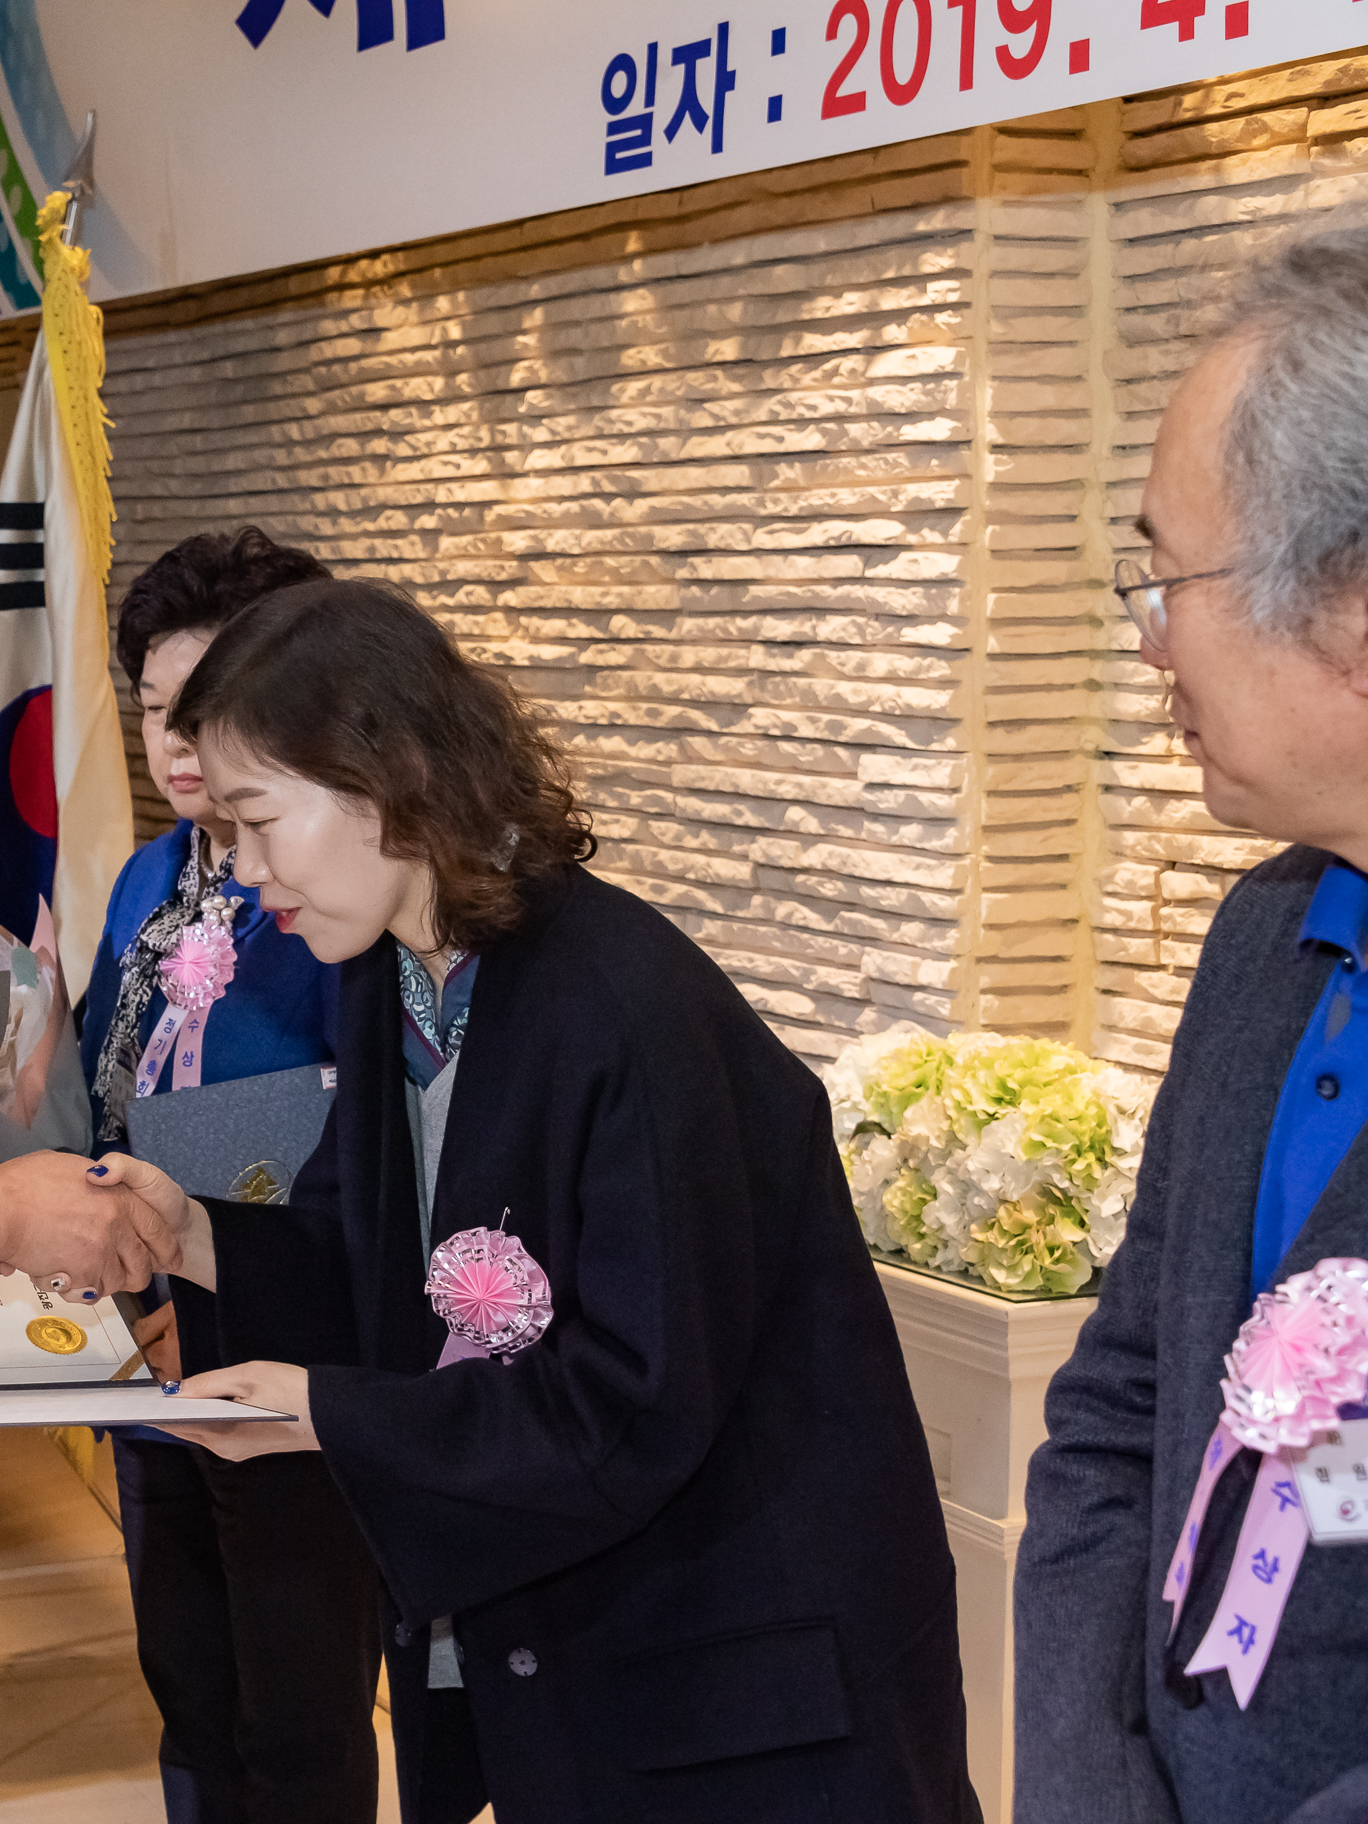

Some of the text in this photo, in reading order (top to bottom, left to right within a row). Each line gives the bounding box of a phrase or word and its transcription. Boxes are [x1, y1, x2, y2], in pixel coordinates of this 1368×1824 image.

[600, 20, 737, 177] 일자
[820, 0, 1091, 121] 2019.
[181, 1018, 200, 1091] 수상
[1226, 1480, 1302, 1656] 수상자
